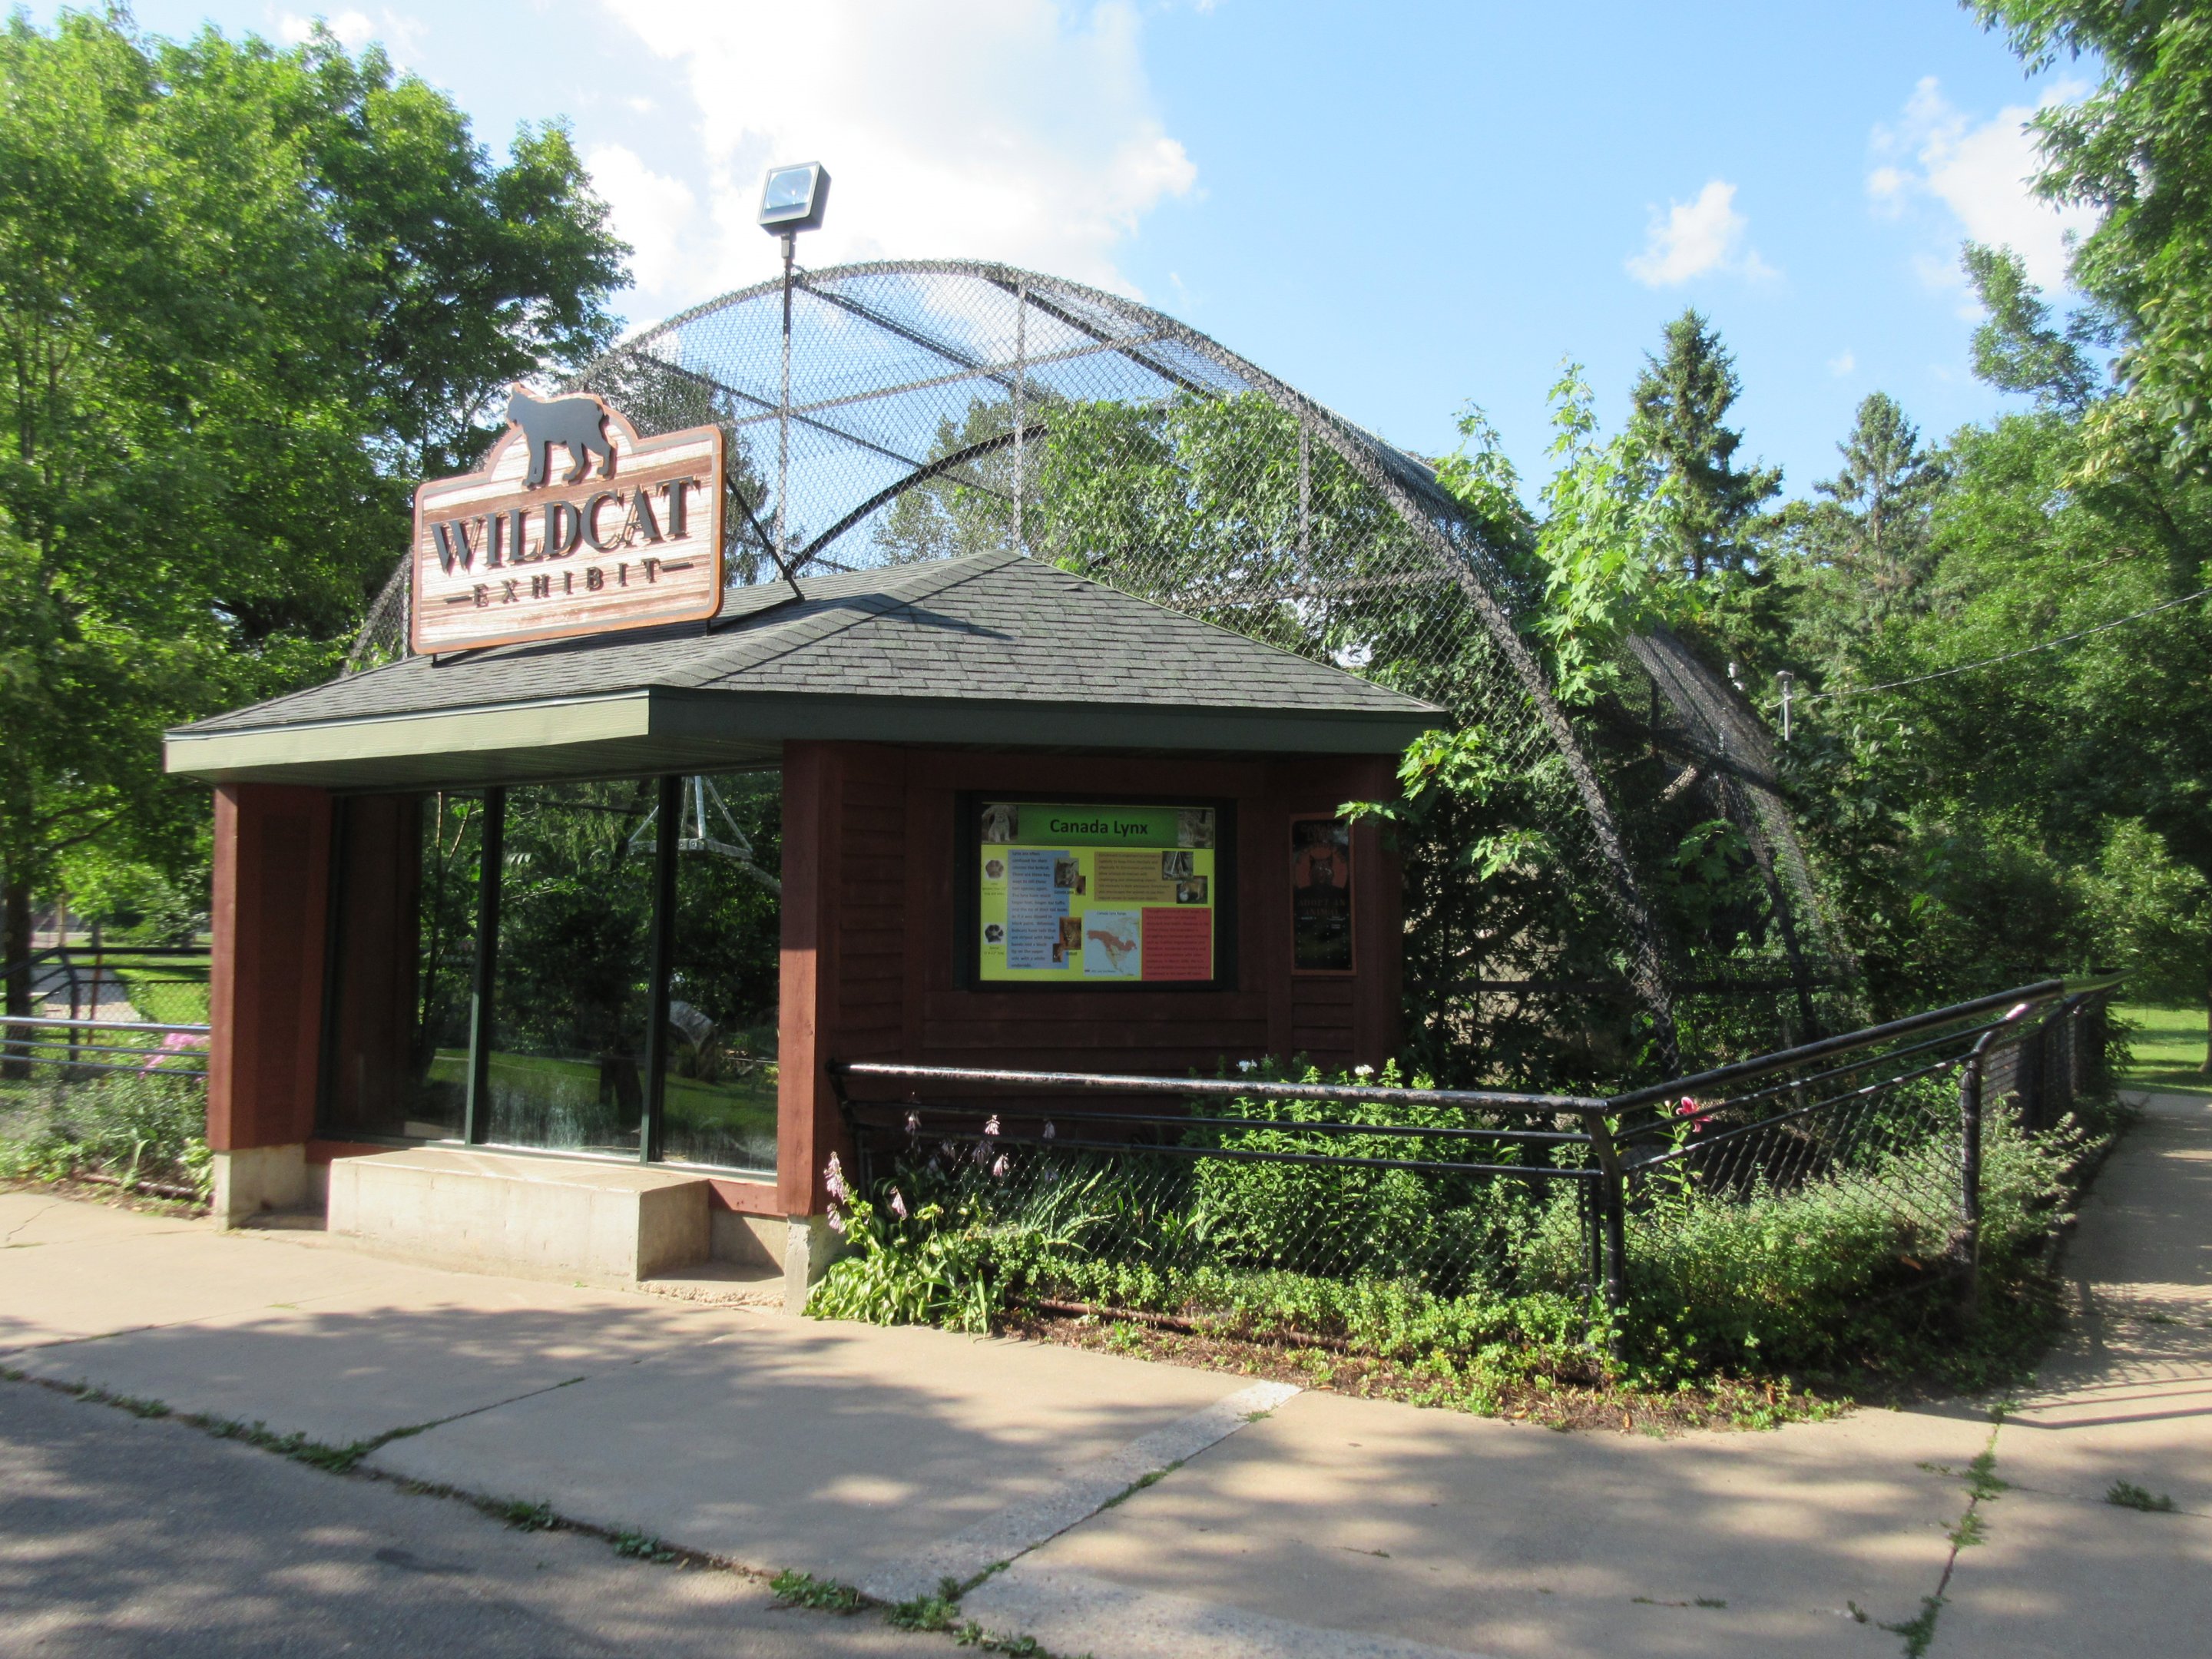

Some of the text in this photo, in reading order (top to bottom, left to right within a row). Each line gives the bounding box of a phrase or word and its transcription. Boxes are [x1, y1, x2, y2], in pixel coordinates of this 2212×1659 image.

[429, 476, 699, 576] WILDCAT
[473, 558, 661, 608] EXHIBIT
[1049, 819, 1149, 838] Canada Lynx
